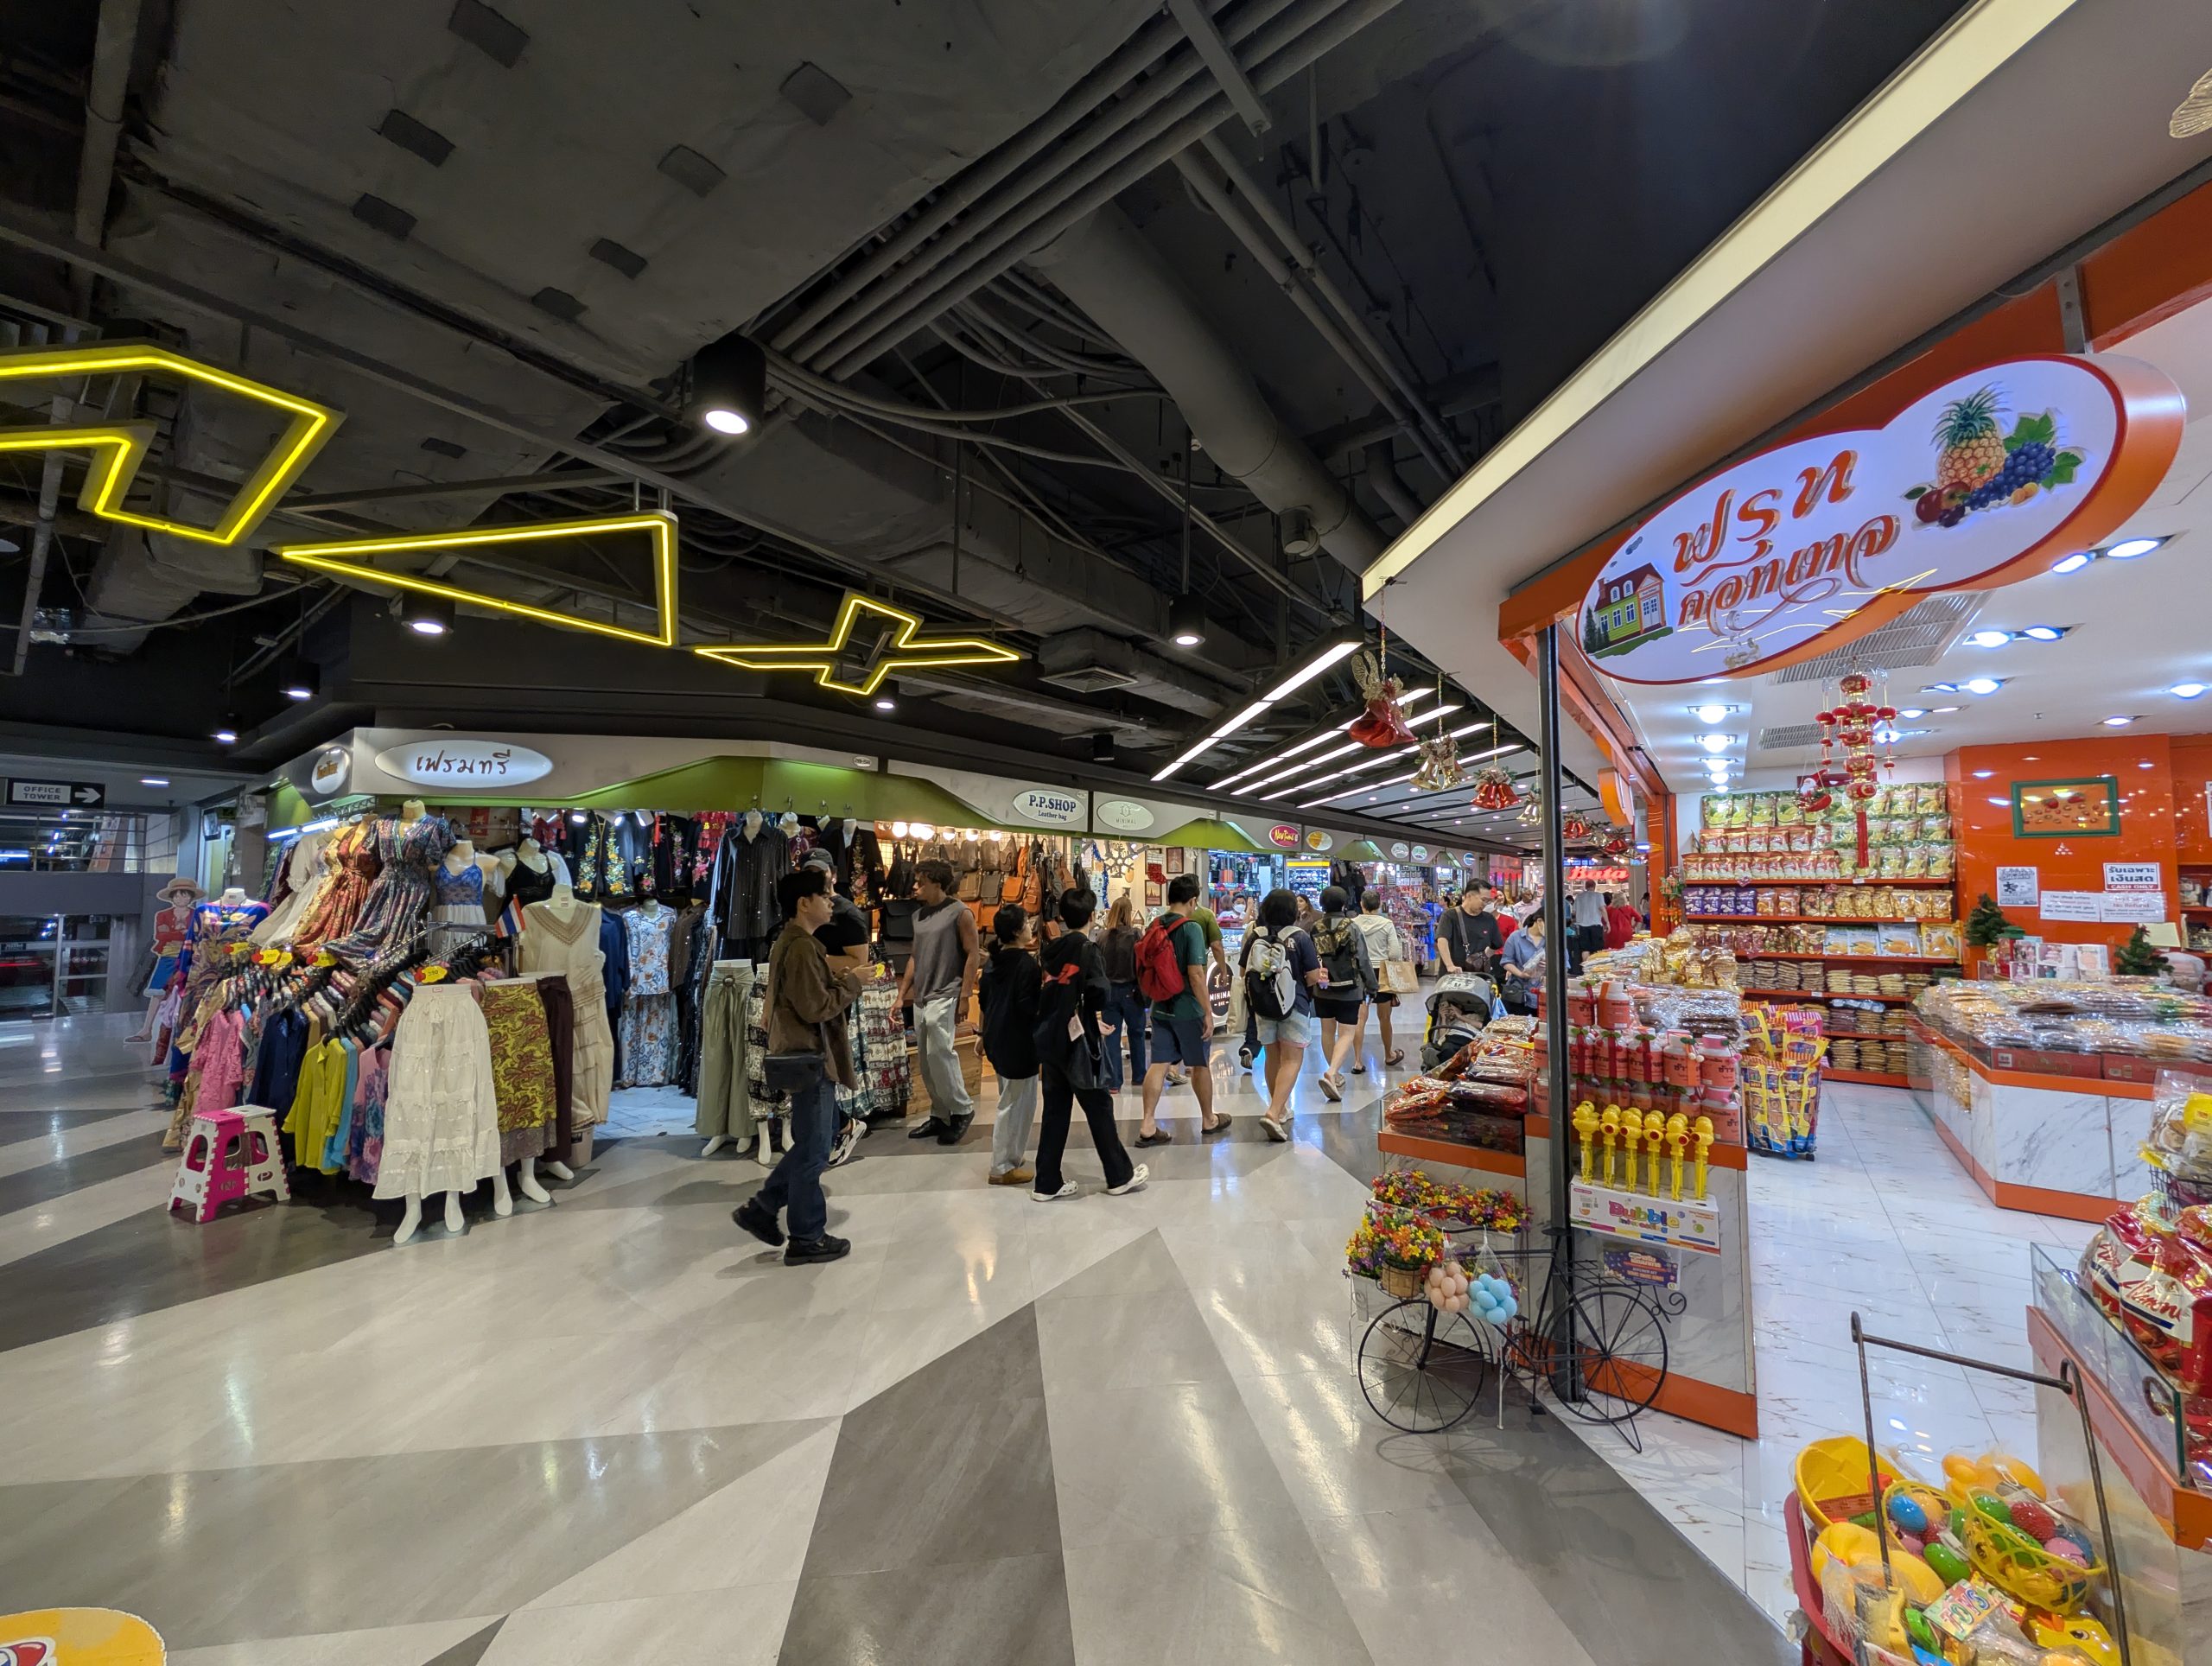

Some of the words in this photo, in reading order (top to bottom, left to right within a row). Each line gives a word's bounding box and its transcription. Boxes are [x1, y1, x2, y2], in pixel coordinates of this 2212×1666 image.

[416, 749, 512, 775] เฟรมทรี
[23, 785, 62, 794] OFFICE
[23, 792, 60, 801] TOWER
[1028, 794, 1077, 813] P.P.SHOP
[1038, 811, 1058, 819] Leather
[1567, 866, 1630, 881] Bata
[2110, 874, 2154, 882] เงินสด
[1209, 991, 1231, 1002] MINIMA
[1609, 1199, 1680, 1229] Bubble
[1941, 1588, 1991, 1634] TOYS
